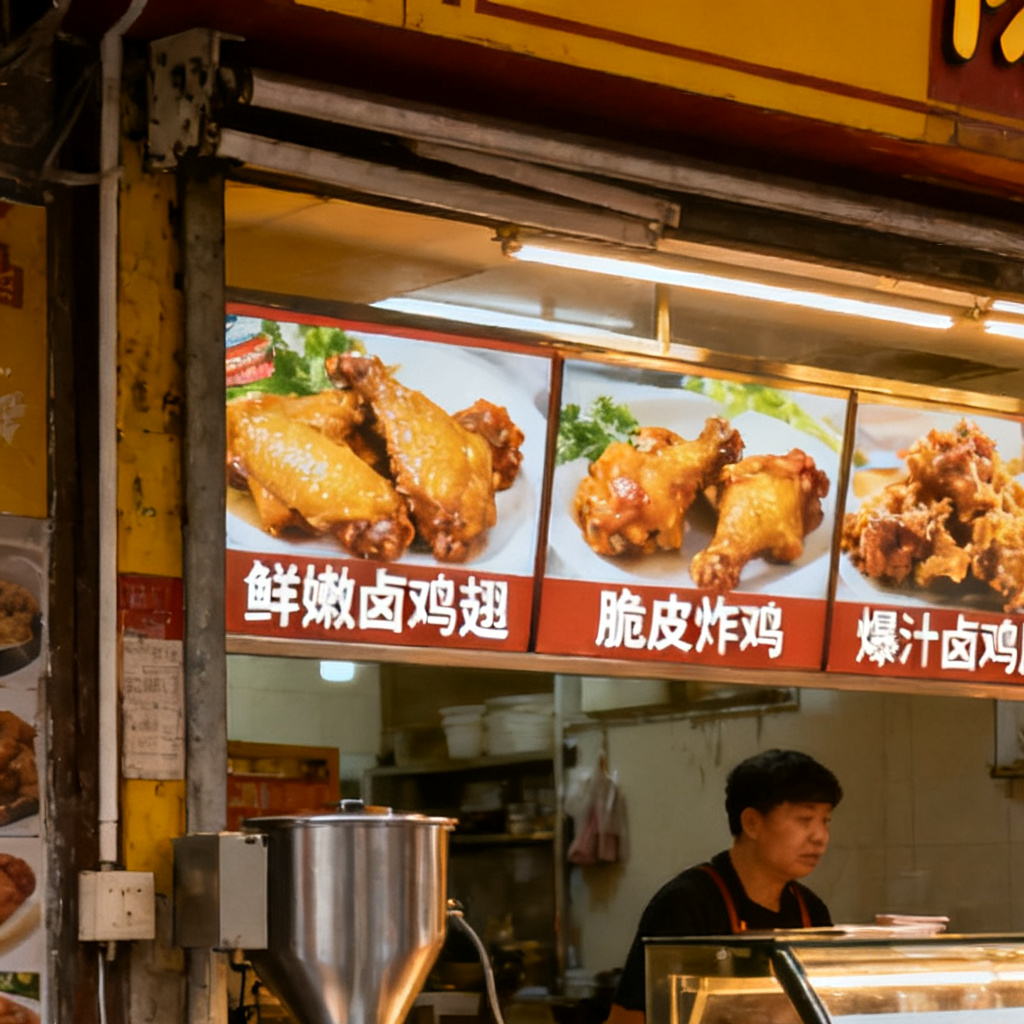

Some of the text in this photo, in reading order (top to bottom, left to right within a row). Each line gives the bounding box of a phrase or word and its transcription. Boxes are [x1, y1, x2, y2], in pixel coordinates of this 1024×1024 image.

[243, 559, 510, 640] 鲜嫩卤鸡翅
[595, 588, 784, 659] 脆皮炸鸡
